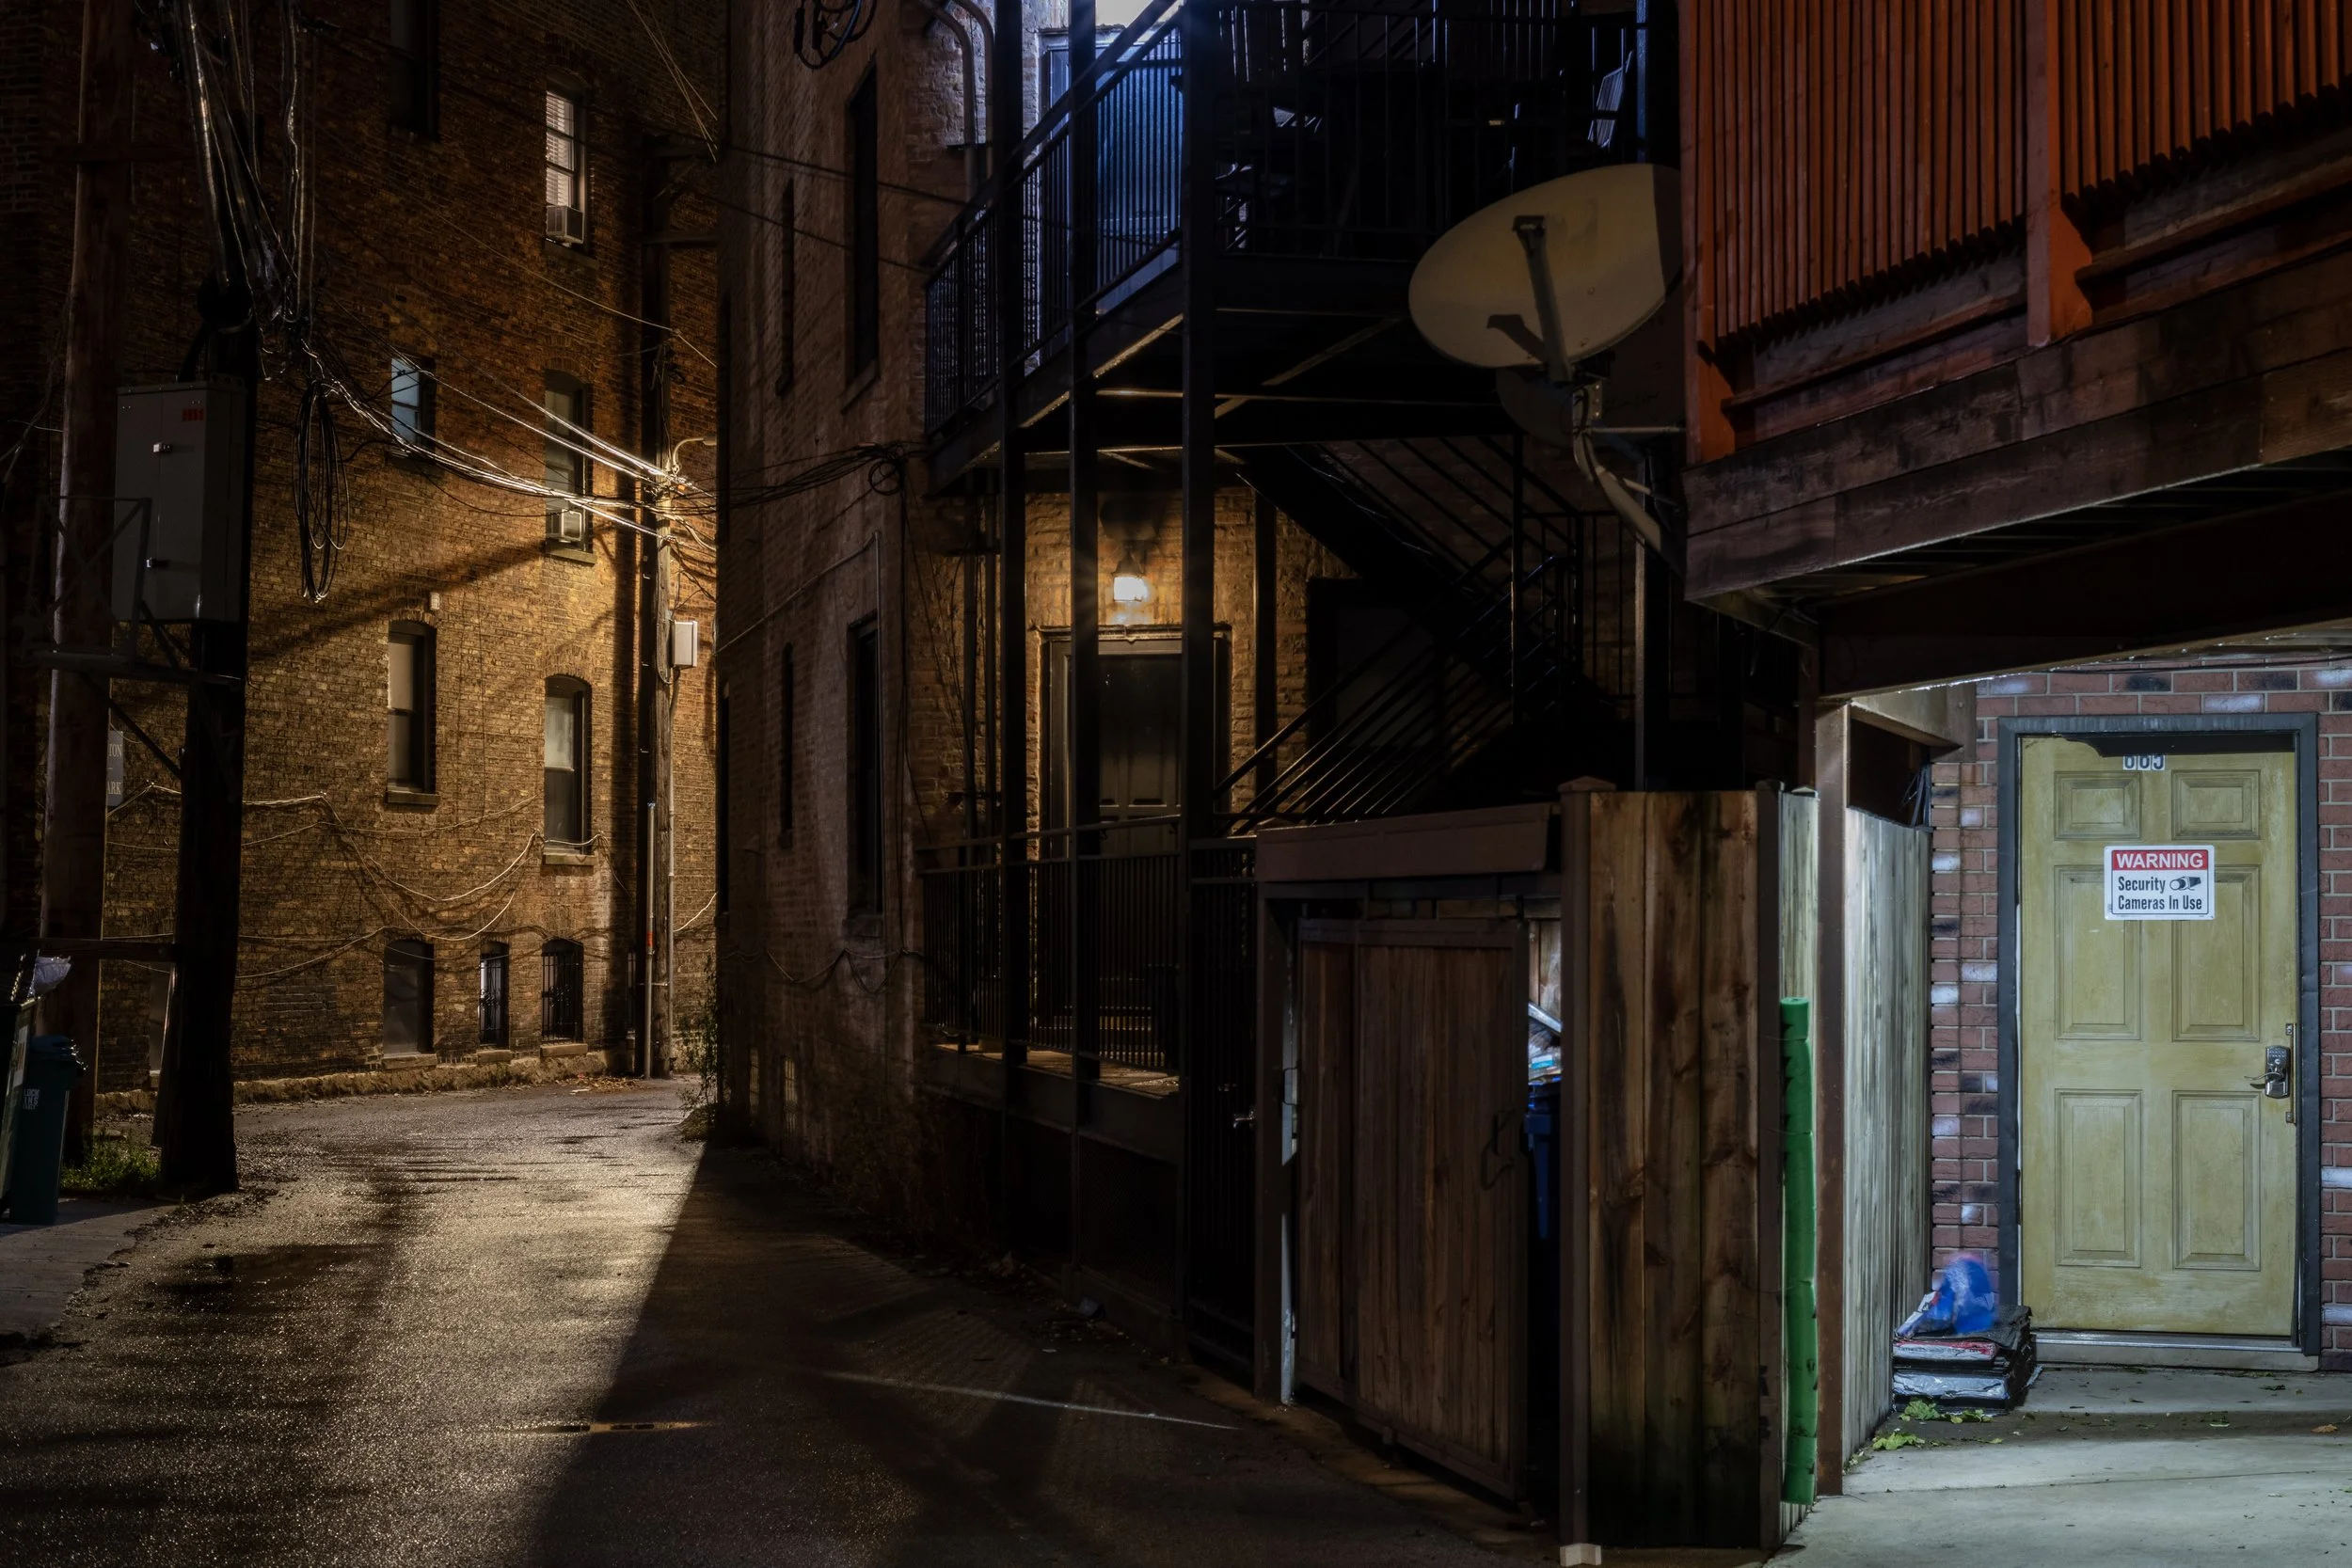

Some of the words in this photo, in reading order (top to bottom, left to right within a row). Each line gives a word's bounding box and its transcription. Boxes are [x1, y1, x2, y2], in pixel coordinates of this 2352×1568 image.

[2116, 852, 2203, 868] WARNING
[2118, 876, 2166, 894] Security
[2118, 895, 2165, 910] Cameras
[2169, 895, 2179, 910] In
[2183, 895, 2202, 910] Use
